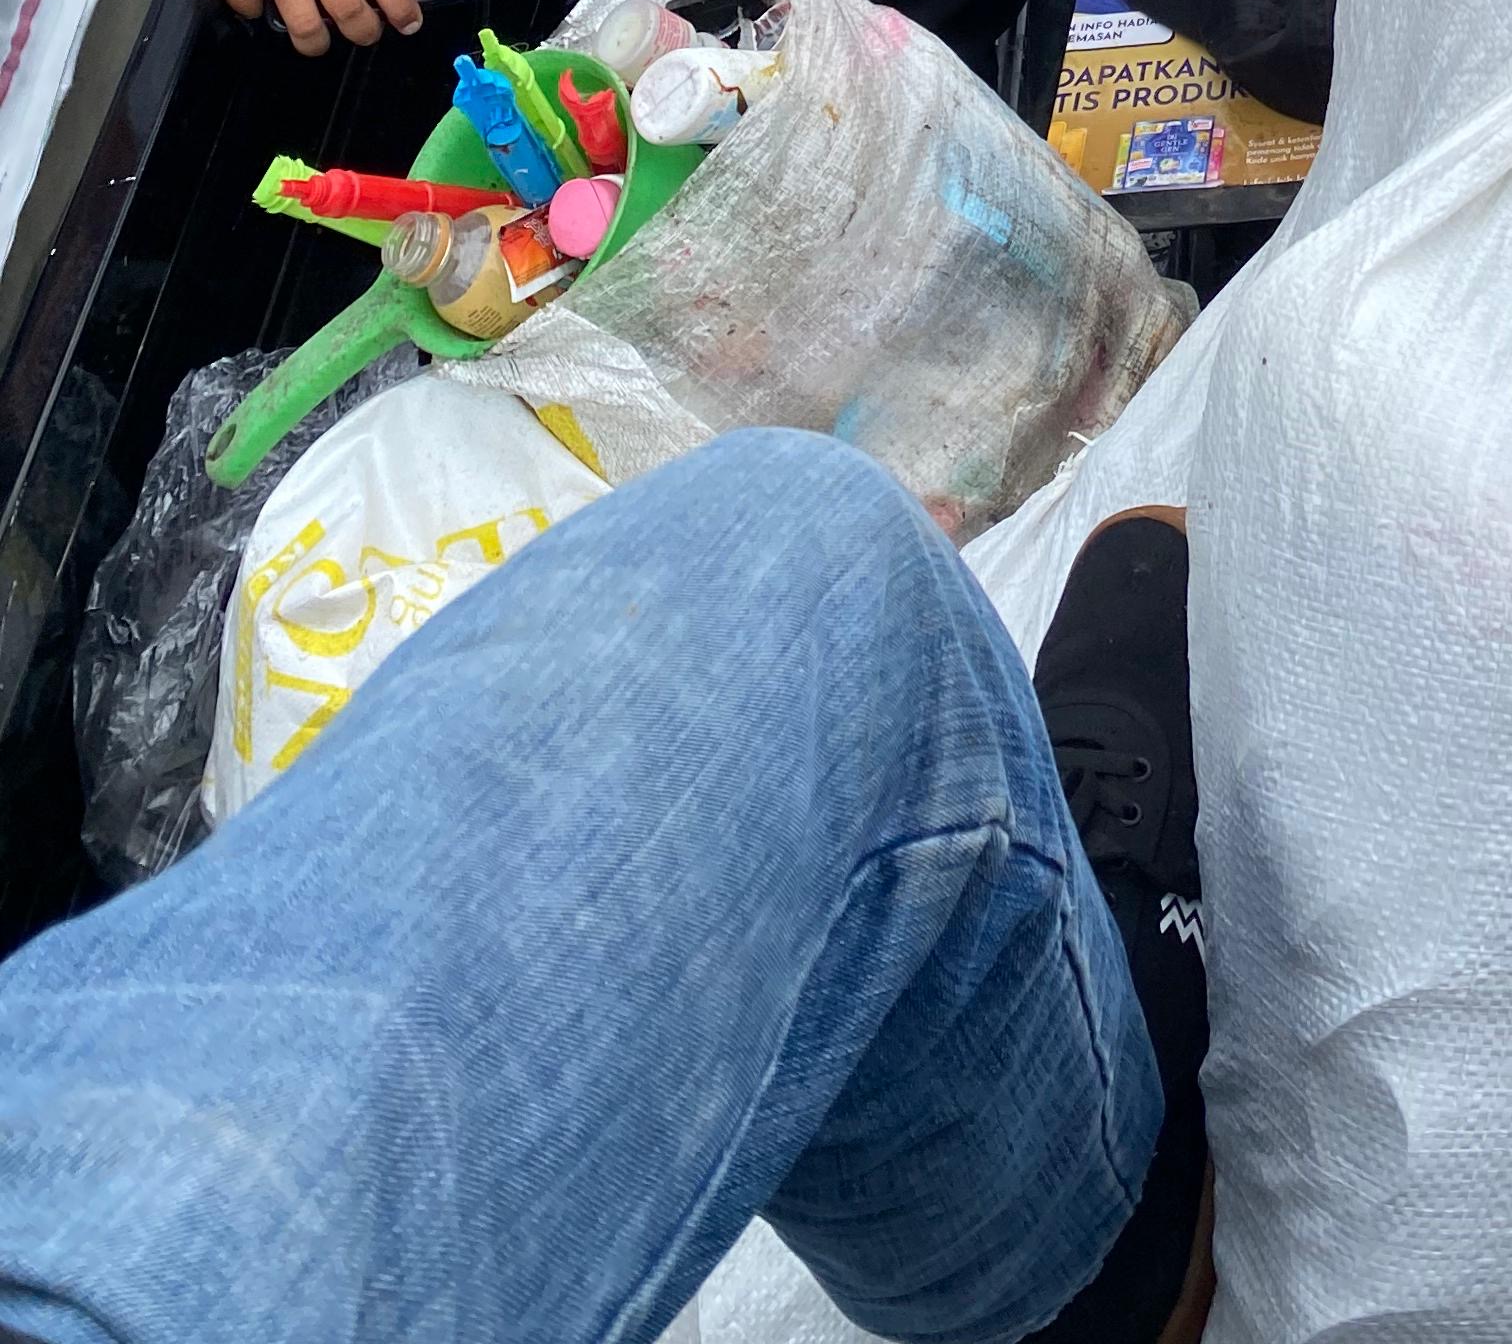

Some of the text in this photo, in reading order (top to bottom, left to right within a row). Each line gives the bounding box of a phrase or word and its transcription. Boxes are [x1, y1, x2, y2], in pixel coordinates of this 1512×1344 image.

[1080, 20, 1112, 32] INFO
[1117, 16, 1158, 29] HADIA
[1066, 30, 1123, 43] EMASAN
[1053, 91, 1099, 114] TIS
